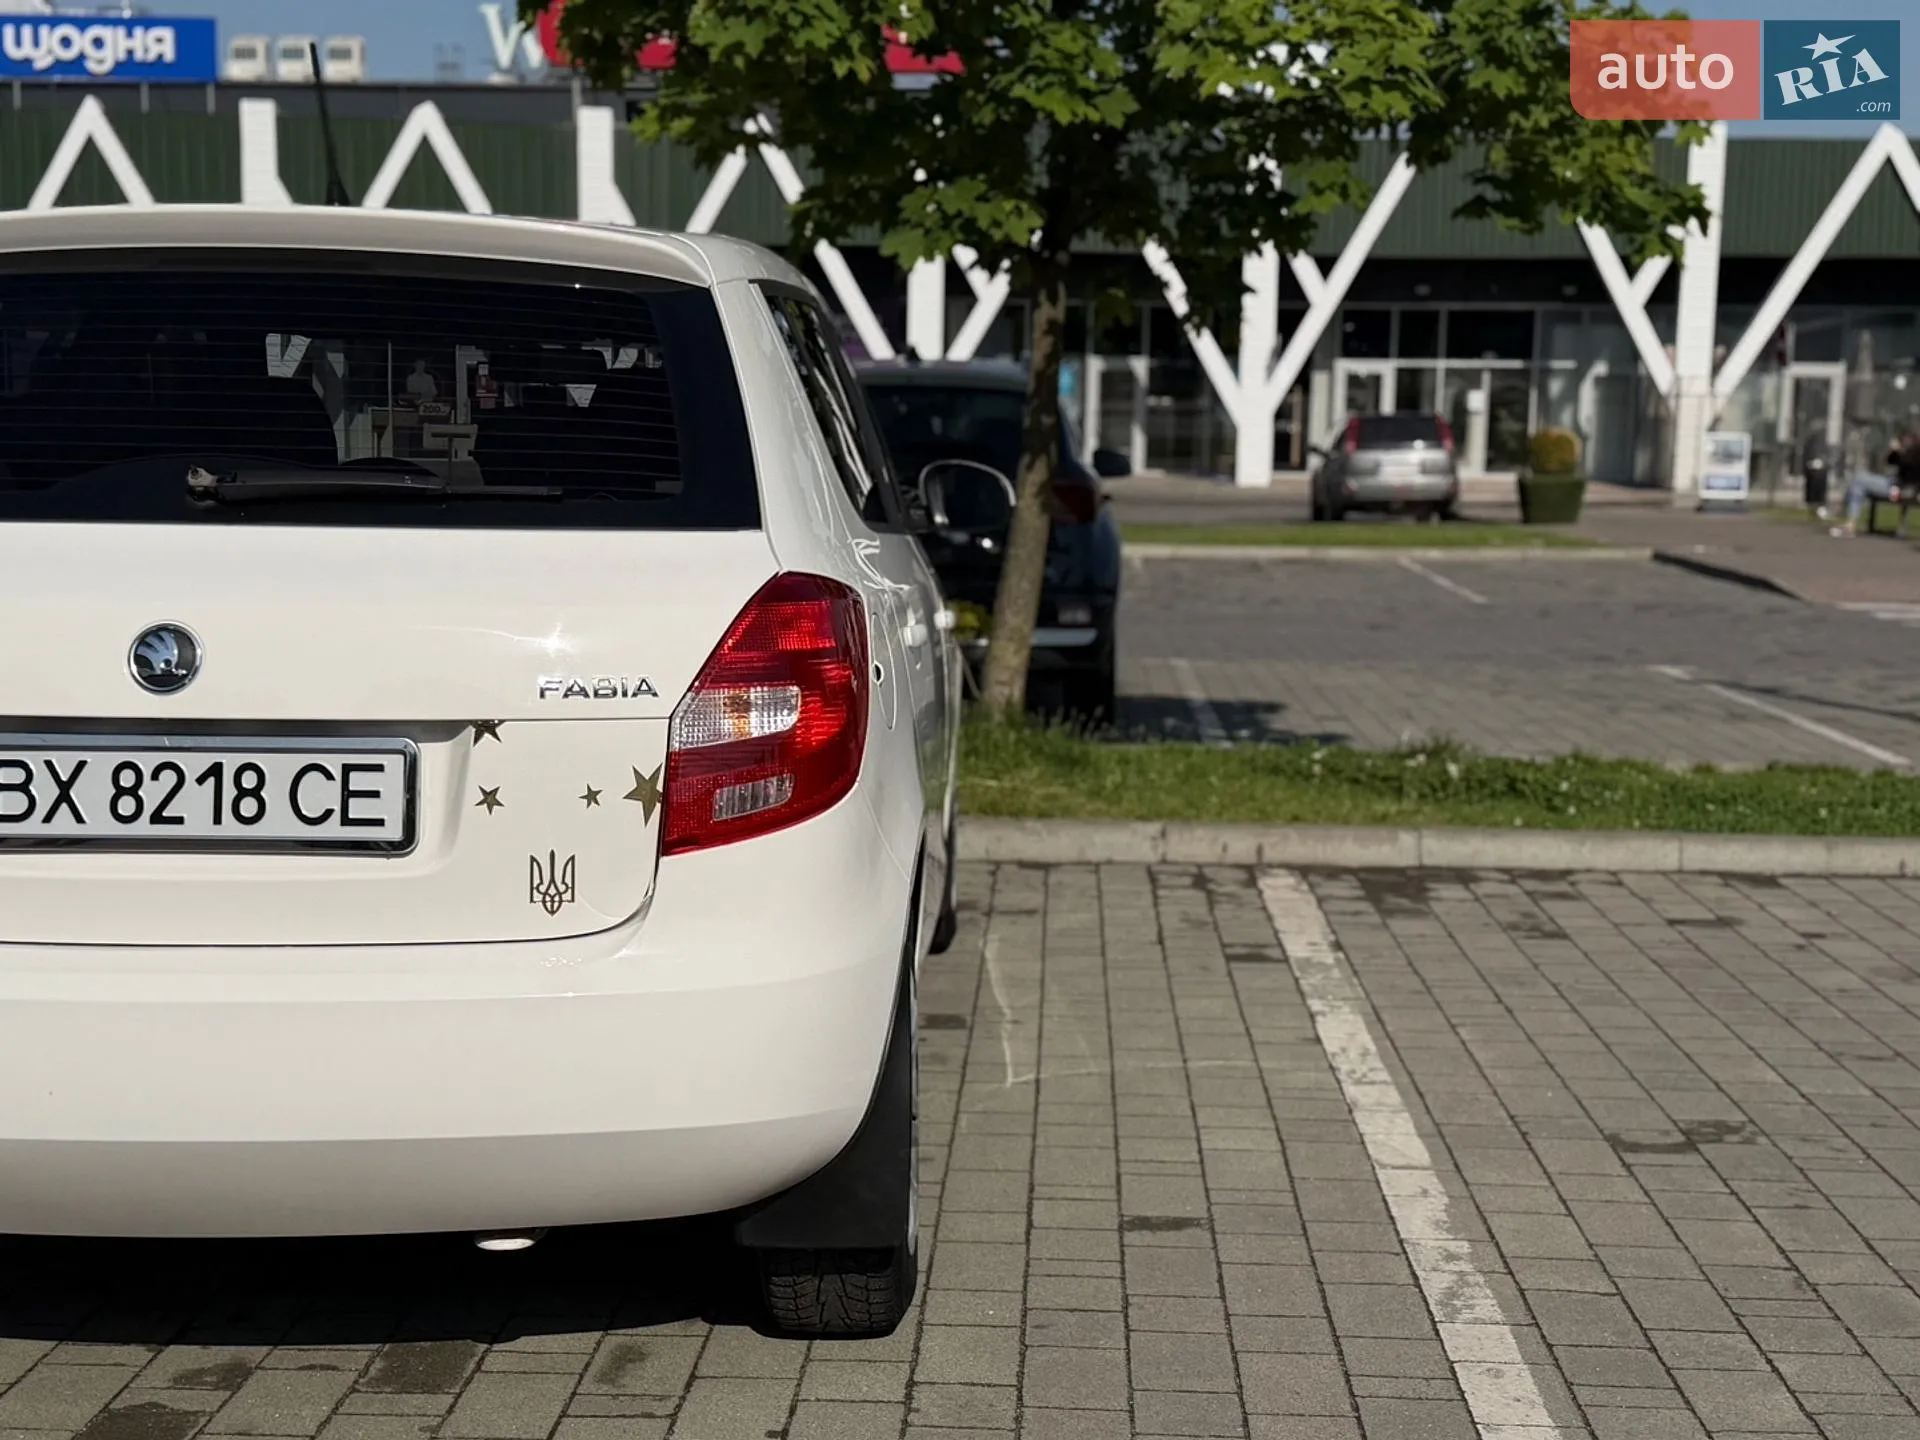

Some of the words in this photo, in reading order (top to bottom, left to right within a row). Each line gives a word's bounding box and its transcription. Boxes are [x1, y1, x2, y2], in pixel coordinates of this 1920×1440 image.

[2, 23, 176, 75] щодня
[538, 676, 660, 699] FABIA
[0, 758, 89, 825] BX
[108, 760, 267, 827] 8218
[289, 762, 386, 828] CE
